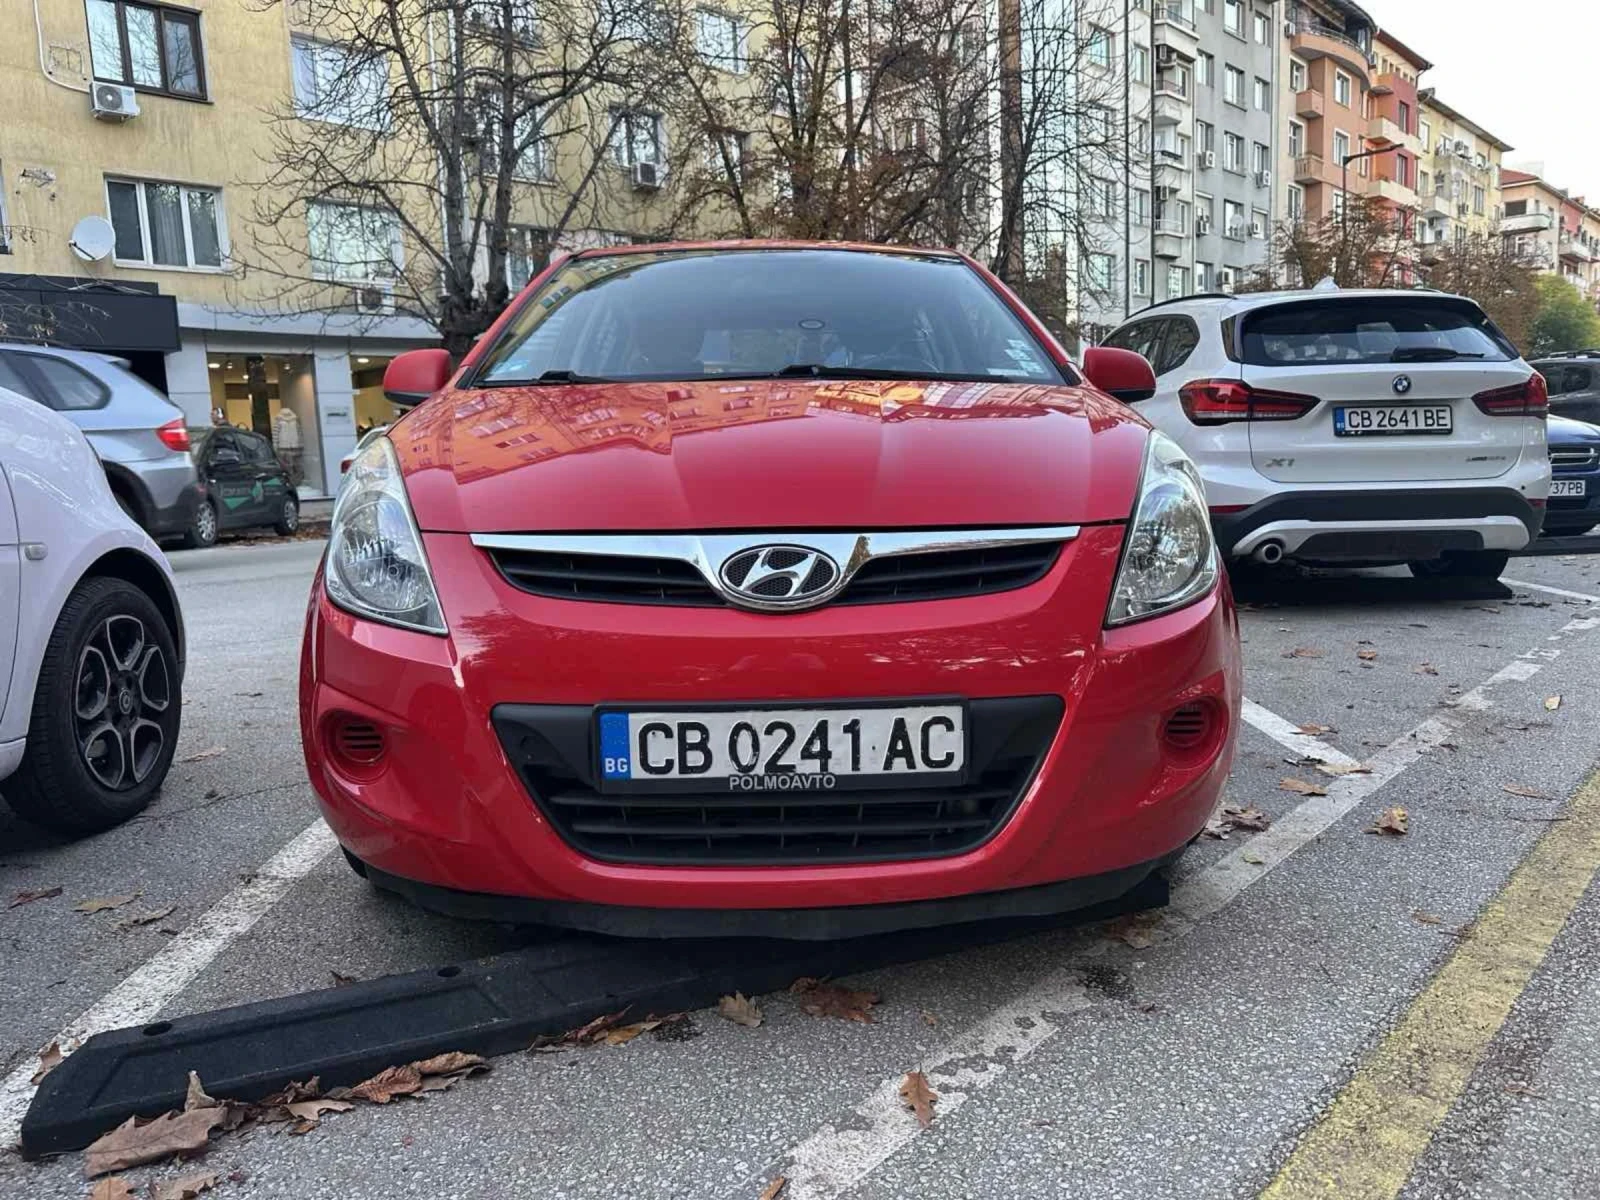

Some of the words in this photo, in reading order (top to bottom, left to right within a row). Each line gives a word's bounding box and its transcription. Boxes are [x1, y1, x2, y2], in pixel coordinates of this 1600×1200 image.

[1348, 410, 1373, 429] CB
[1376, 409, 1418, 428] 2641
[1424, 408, 1448, 427] BE
[1550, 482, 1566, 495] 37
[1567, 481, 1584, 495] PB
[638, 721, 713, 776] CB
[728, 718, 860, 774] 0241
[883, 715, 955, 772] AC
[605, 758, 628, 773] BG
[729, 774, 837, 791] POLMOAVTO
